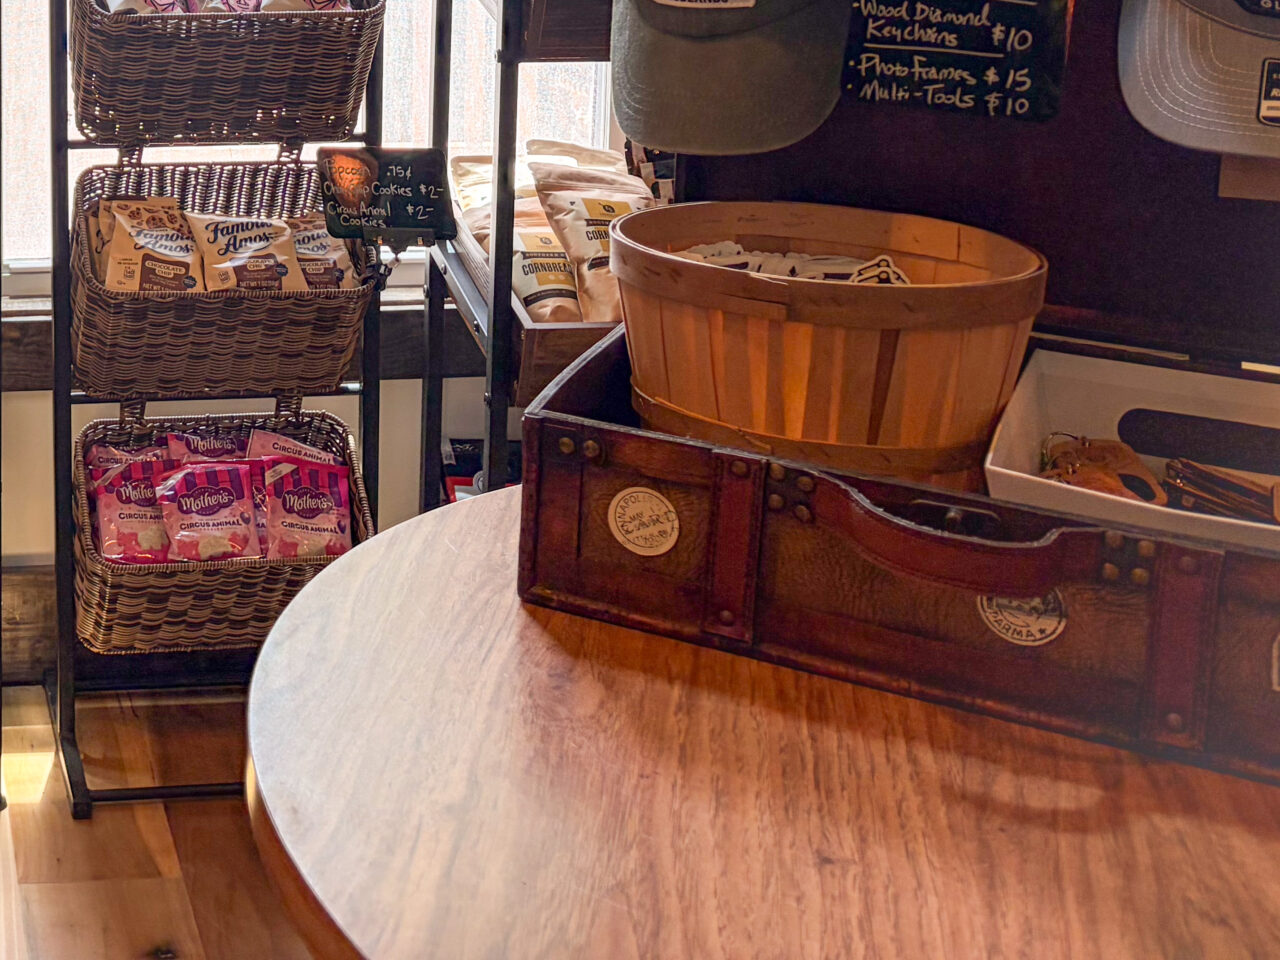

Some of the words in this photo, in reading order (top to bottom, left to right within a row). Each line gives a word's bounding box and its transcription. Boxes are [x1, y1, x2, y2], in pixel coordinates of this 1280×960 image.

[914, 1, 991, 26] Diamond
[866, 19, 958, 47] Keychains
[992, 23, 1032, 51] $10
[858, 53, 909, 77] Photo
[913, 55, 976, 85] Frames
[860, 80, 975, 108] Multi-Tools
[372, 182, 413, 197] Cookies
[327, 201, 357, 215] Circus
[360, 201, 391, 217] Animal
[340, 215, 386, 228] Cookies
[134, 240, 190, 254] Amos
[217, 232, 268, 256] Amos
[147, 261, 184, 273] CHOCOLATE
[190, 437, 233, 450] Mother's
[98, 456, 121, 464] CIRCUS
[272, 442, 300, 456] CIRCUS
[301, 449, 331, 464] ANIMAL
[120, 487, 155, 503] Mothe
[180, 492, 234, 511] Mother's
[285, 494, 333, 512] Mother's
[118, 512, 147, 520] CIRCUS
[180, 520, 211, 530] CIRCUS
[211, 519, 242, 528] ANIMAL
[281, 520, 310, 531] CIRCUS
[310, 525, 339, 535] ANIMAL
